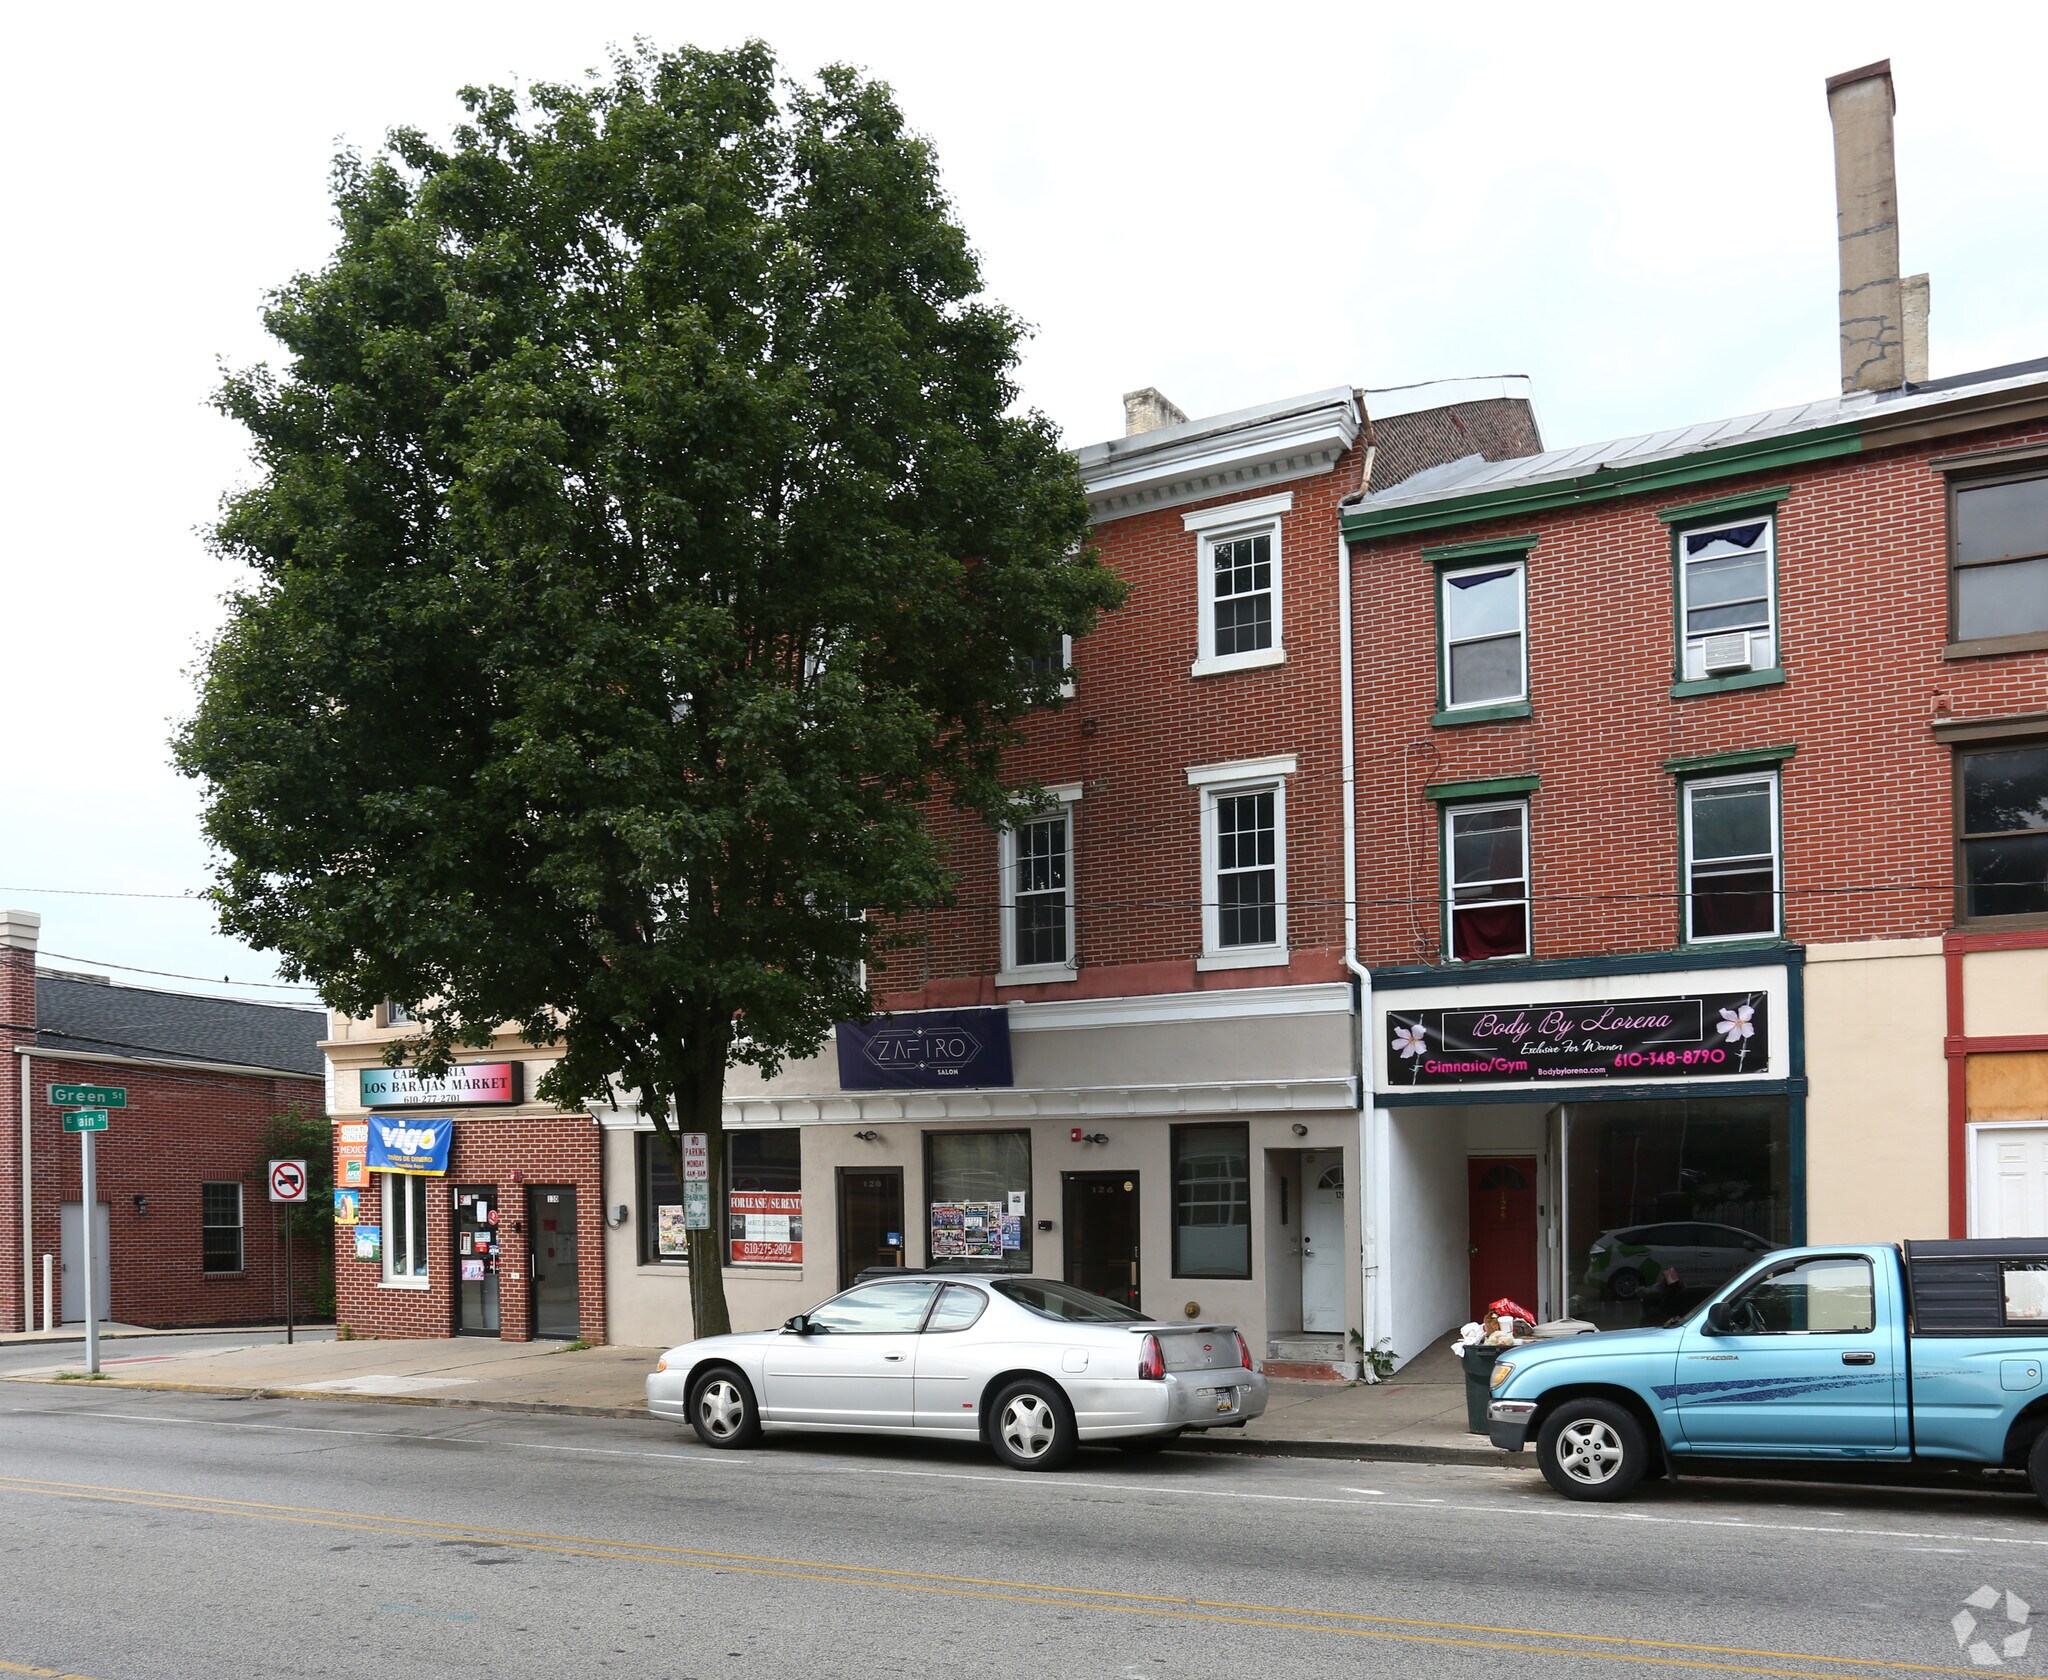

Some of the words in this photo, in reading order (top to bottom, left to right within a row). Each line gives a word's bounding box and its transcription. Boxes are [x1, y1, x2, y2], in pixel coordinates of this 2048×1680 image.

[1472, 1011, 1532, 1044] Body
[1537, 1009, 1575, 1042] By
[1580, 1006, 1673, 1032] Lorena
[877, 1038, 966, 1061] ZAFIRO
[1520, 1040, 1561, 1056] Exclusive
[1561, 1039, 1580, 1054] For
[1582, 1038, 1623, 1052] Women
[937, 1068, 959, 1076] SALON
[1424, 1057, 1528, 1074] Gimnasio/Gym
[1538, 1066, 1606, 1076] Bodybylorena.com
[364, 1082, 387, 1094] LOS
[391, 1079, 446, 1095] BARAJAS
[451, 1077, 508, 1091] MARKET
[55, 1089, 106, 1102] Green
[112, 1091, 123, 1099] St
[403, 1094, 460, 1104] 610-277-2701
[76, 1115, 95, 1127] ain
[97, 1114, 106, 1122] St
[382, 1120, 436, 1156] vigo
[691, 1137, 699, 1146] NO
[685, 1147, 706, 1157] PARKING
[686, 1160, 705, 1168] MONDAY
[730, 1197, 746, 1208] FOR
[746, 1197, 767, 1209] LEASE
[771, 1198, 781, 1209] SE
[782, 1198, 803, 1210] RENT
[744, 1243, 792, 1255] 610-275-2904
